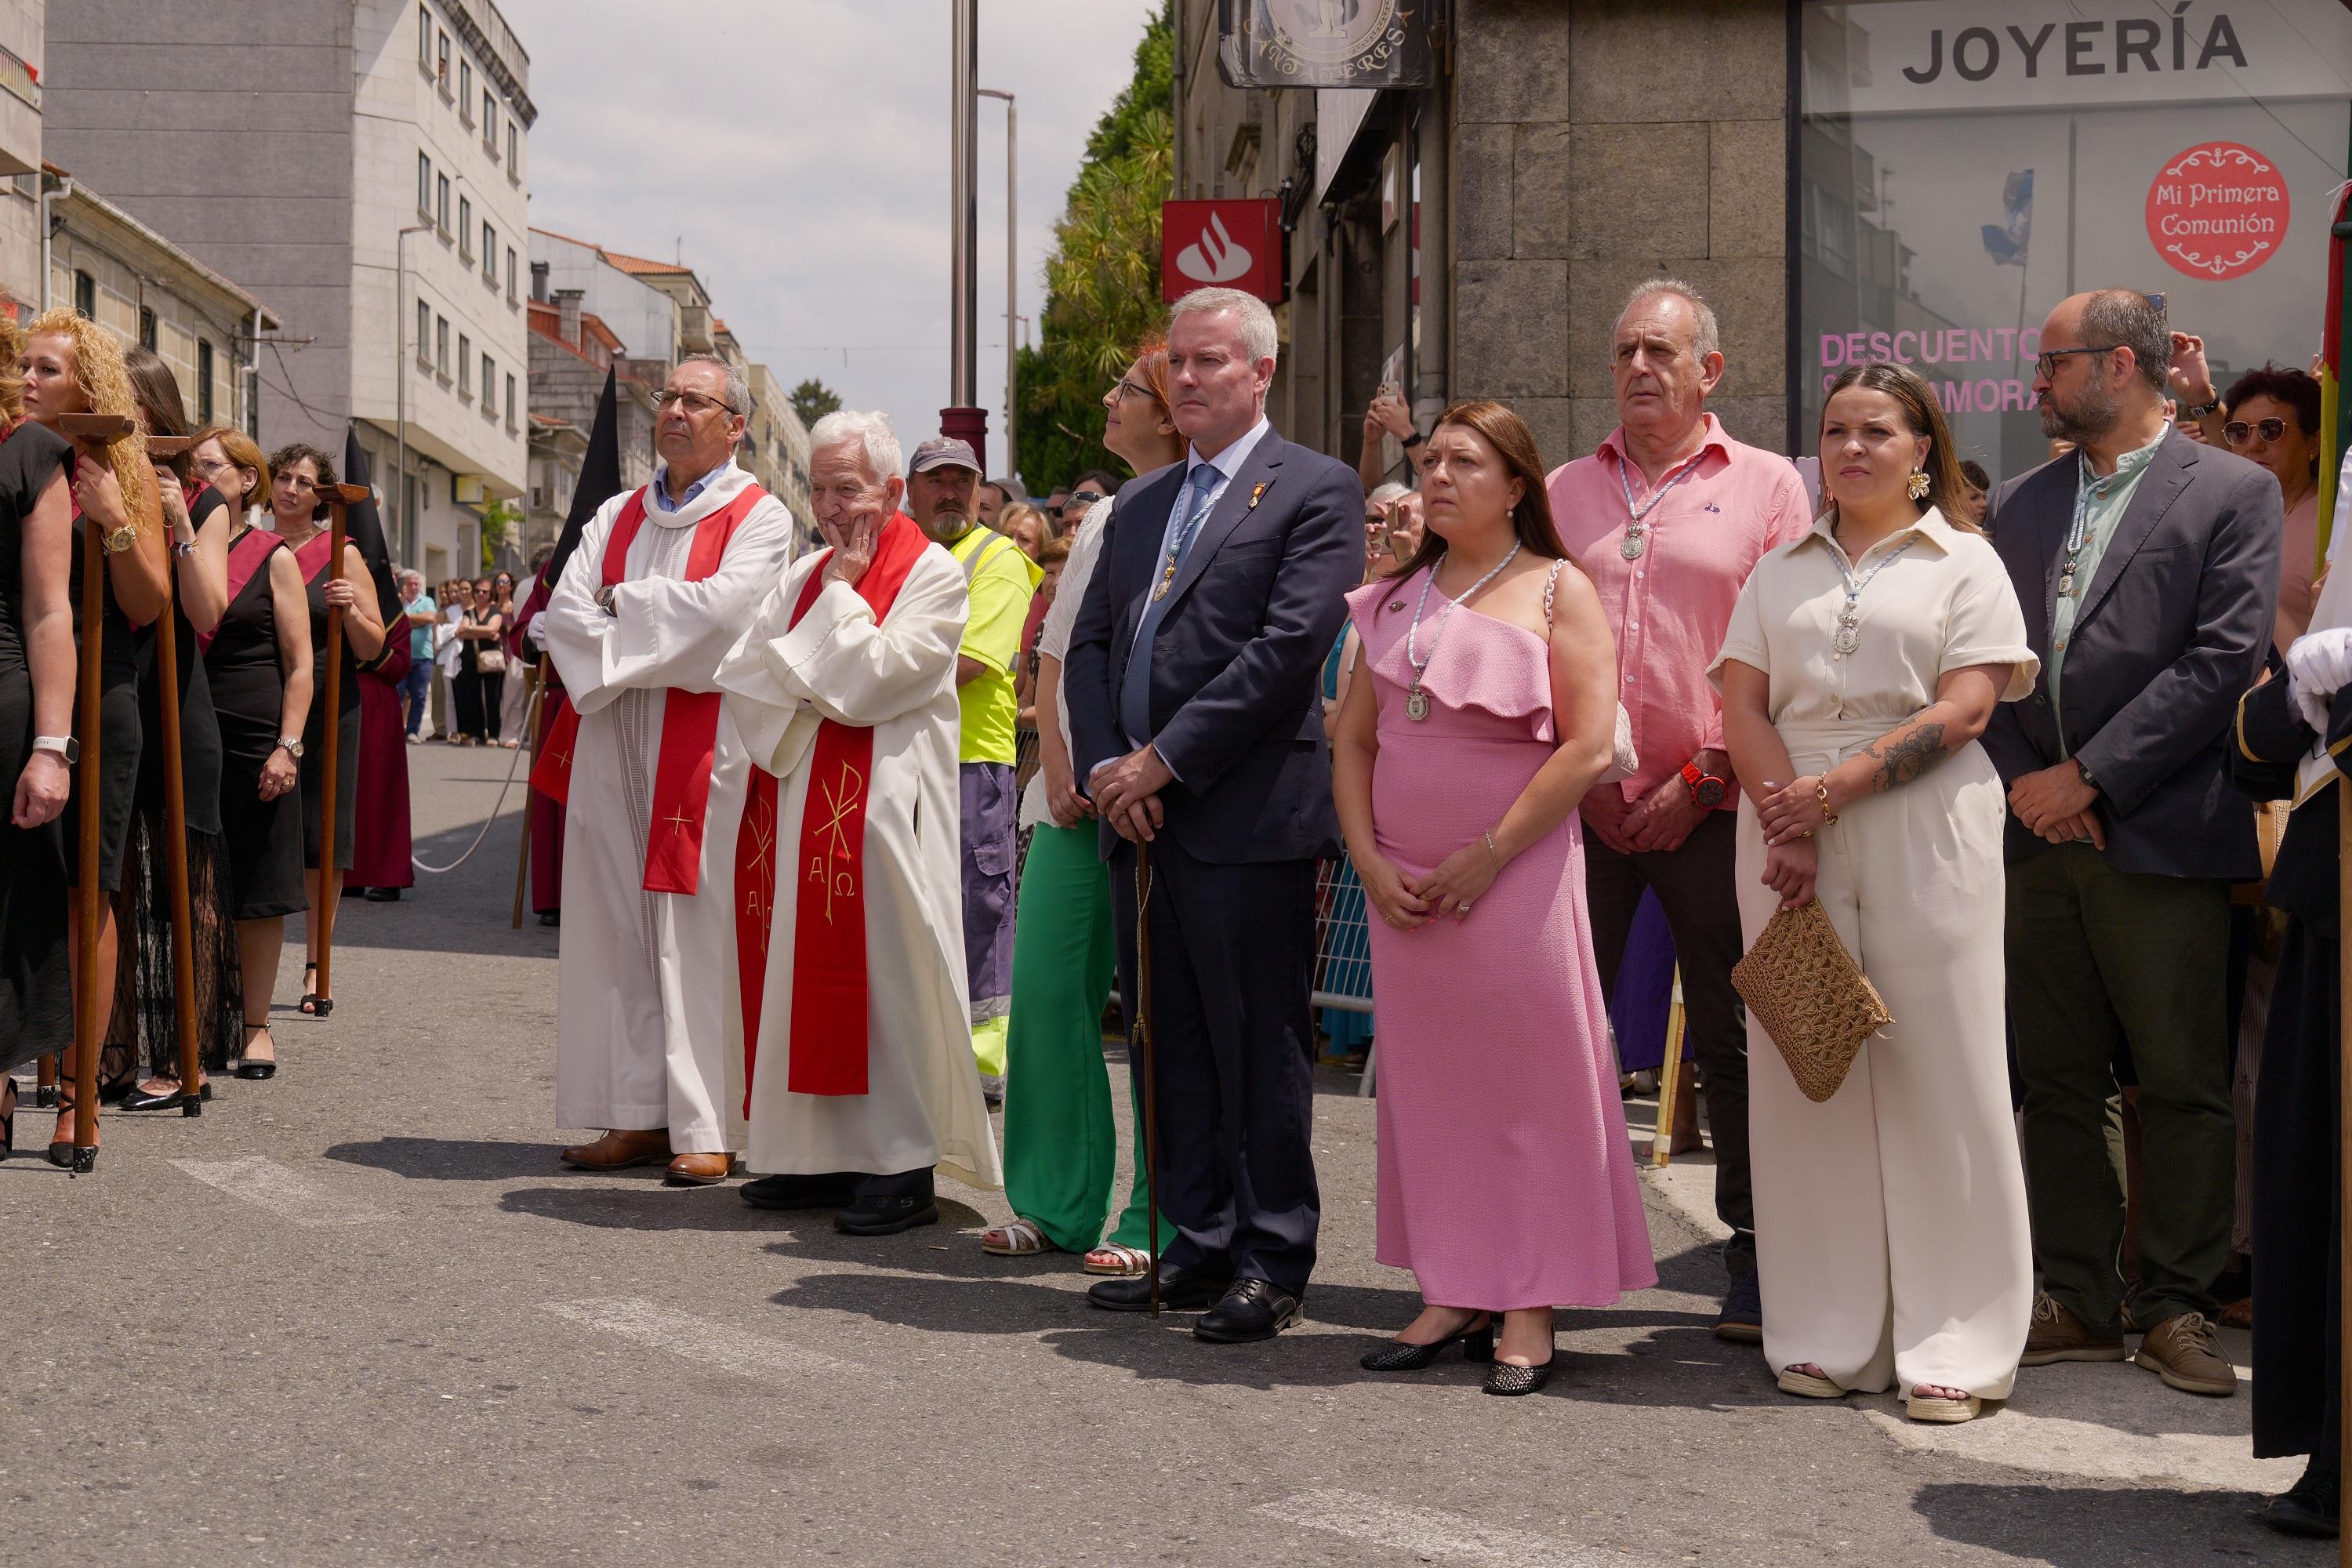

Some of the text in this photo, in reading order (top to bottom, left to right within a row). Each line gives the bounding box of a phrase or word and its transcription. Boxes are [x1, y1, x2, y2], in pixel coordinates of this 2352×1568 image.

[1902, 1, 2249, 84] JOYERÍA
[2156, 183, 2280, 208] Mi Primera
[2161, 213, 2274, 235] Comunión
